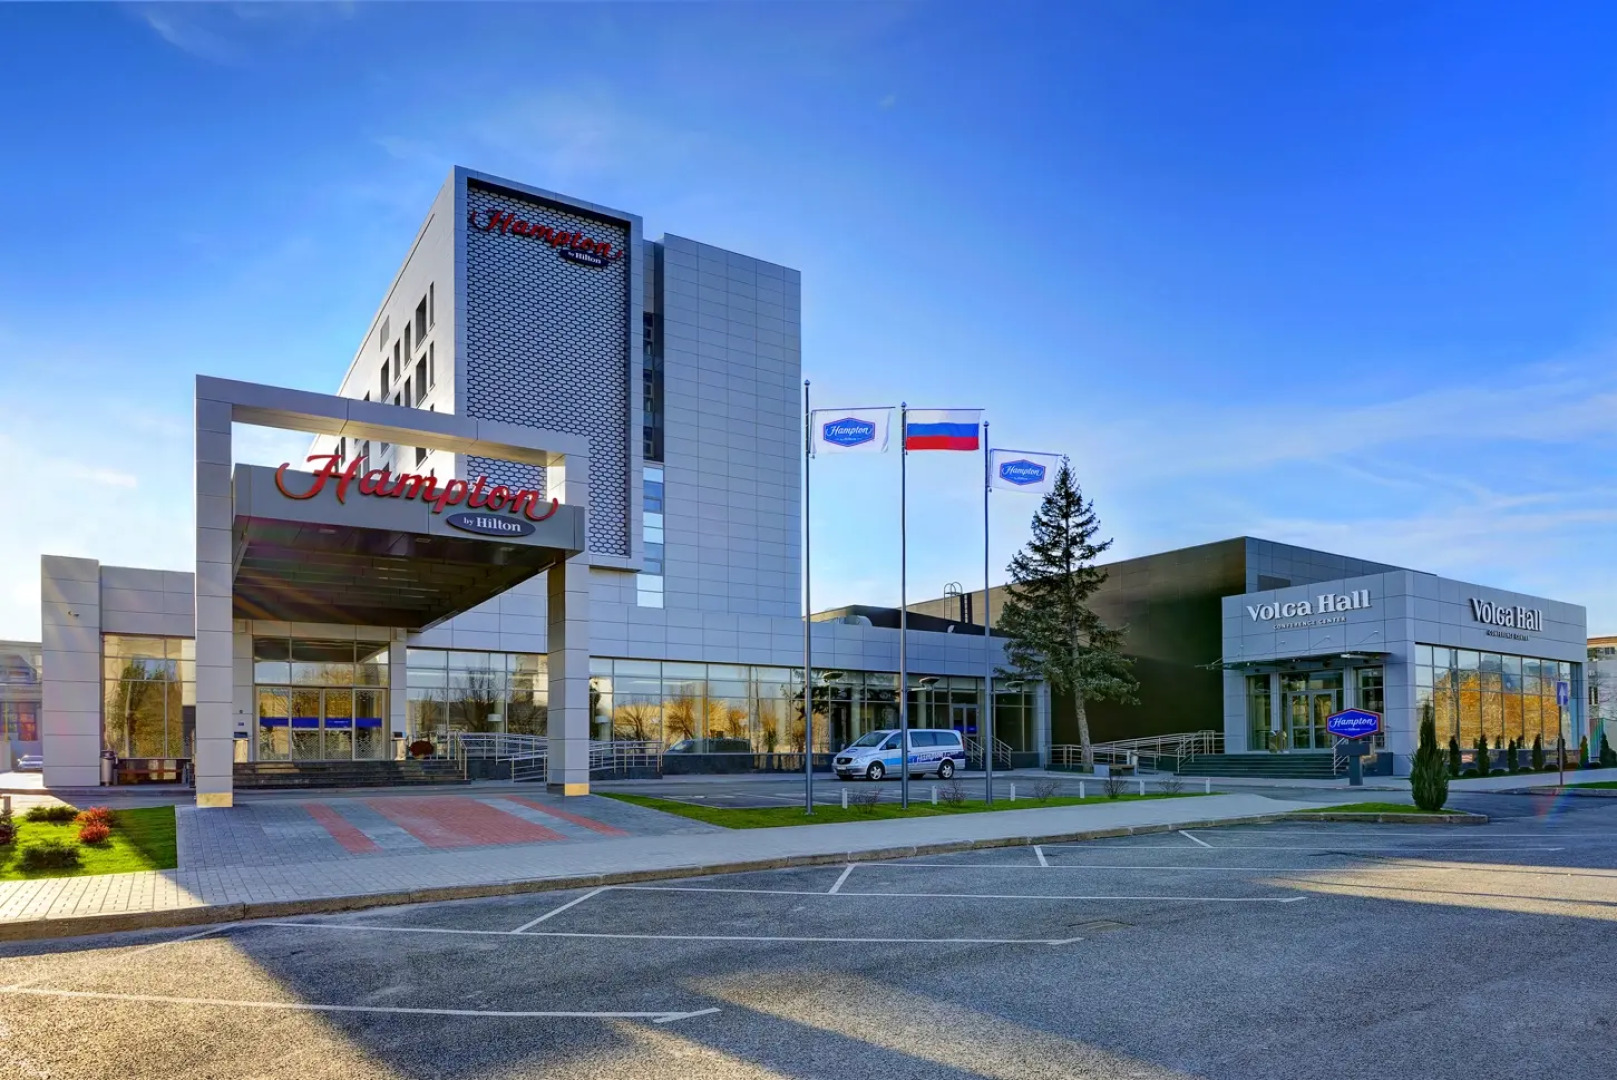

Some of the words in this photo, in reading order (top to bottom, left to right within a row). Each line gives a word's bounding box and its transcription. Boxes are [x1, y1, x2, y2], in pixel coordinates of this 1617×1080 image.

[471, 208, 621, 258] Hampton
[576, 253, 601, 264] Hilton
[826, 426, 872, 436] Hampton
[1002, 466, 1043, 476] Hampton
[275, 454, 558, 521] Hampton
[463, 517, 474, 526] by
[476, 516, 521, 532] Hilton
[1317, 589, 1371, 613] Hall
[1516, 606, 1542, 631] Hall
[1330, 717, 1376, 728] Hampton
